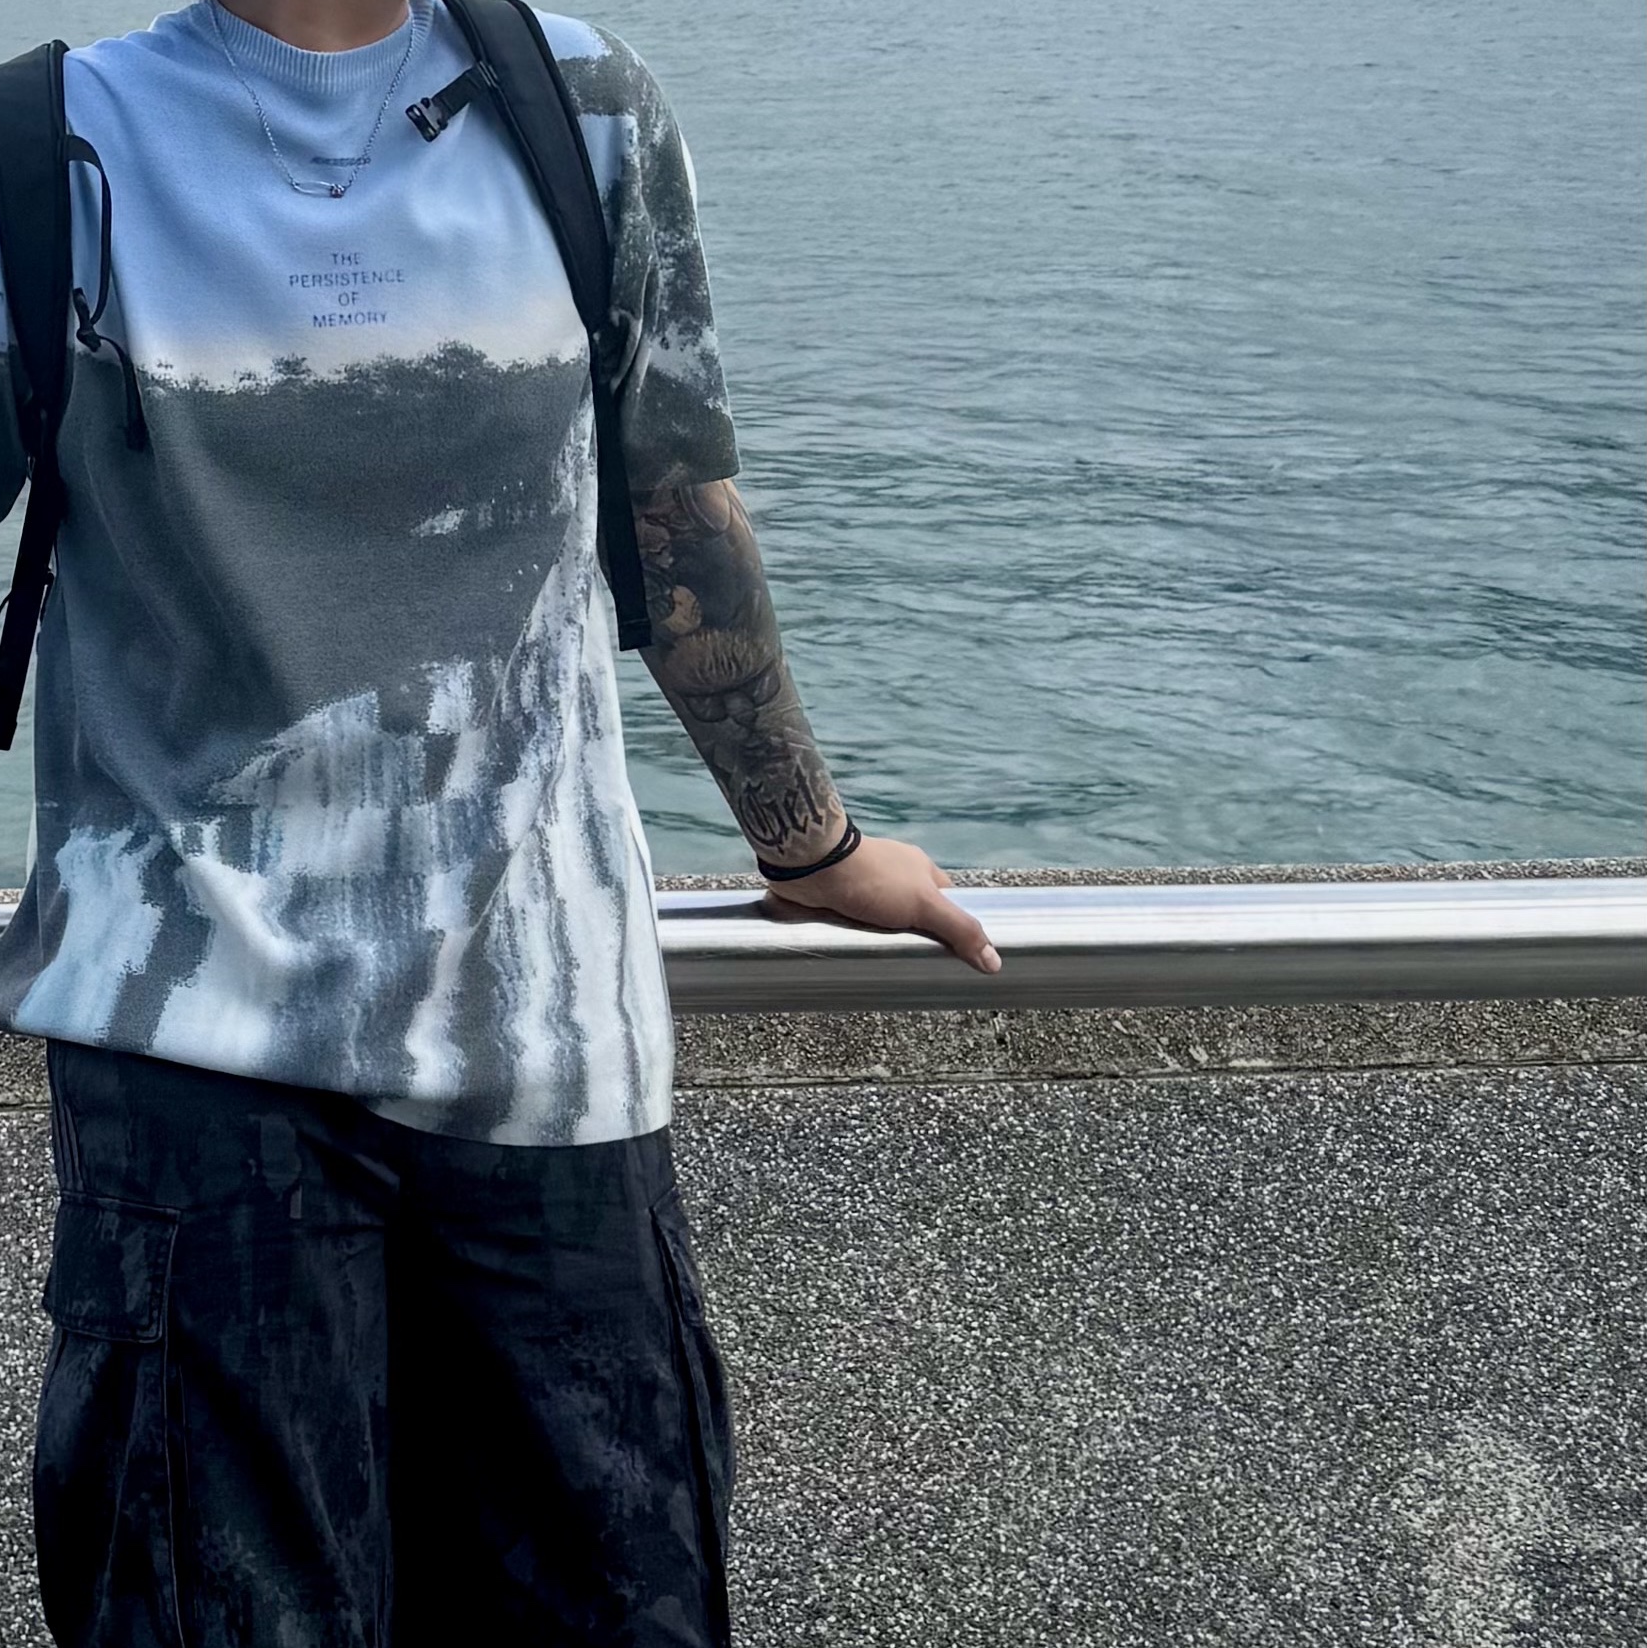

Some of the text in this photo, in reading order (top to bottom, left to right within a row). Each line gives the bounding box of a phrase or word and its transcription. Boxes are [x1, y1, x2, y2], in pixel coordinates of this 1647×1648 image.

[331, 253, 362, 266] THE
[288, 269, 405, 288] PERSISTENCE
[337, 291, 359, 307] OF
[312, 311, 387, 328] MEMORY
